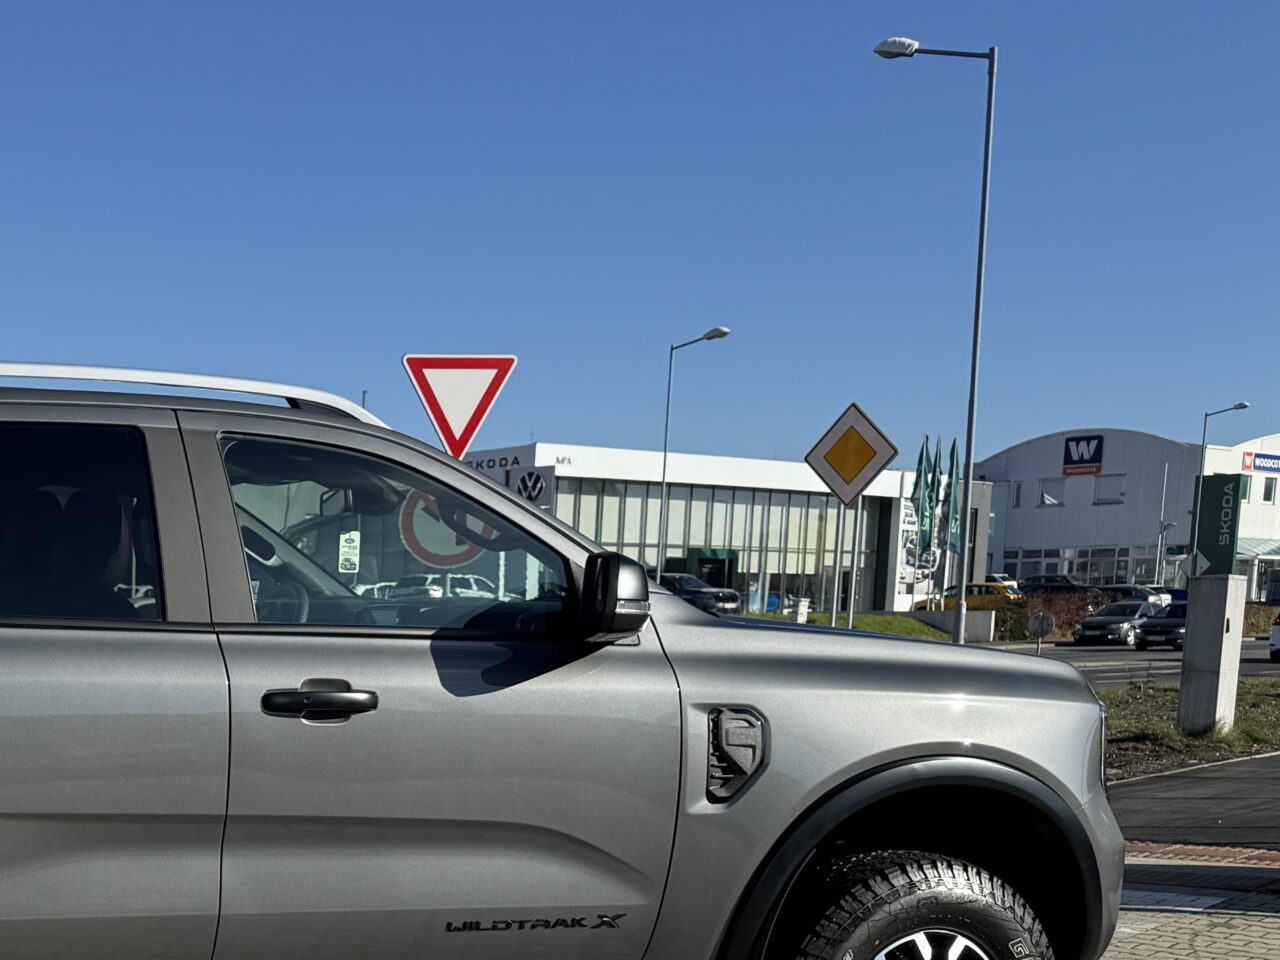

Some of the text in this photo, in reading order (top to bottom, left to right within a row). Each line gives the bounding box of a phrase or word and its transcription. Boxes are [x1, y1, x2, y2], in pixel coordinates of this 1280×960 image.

[1068, 440, 1098, 461] W
[1255, 457, 1280, 469] WOODCO
[445, 913, 627, 933] WILDTRAK X
